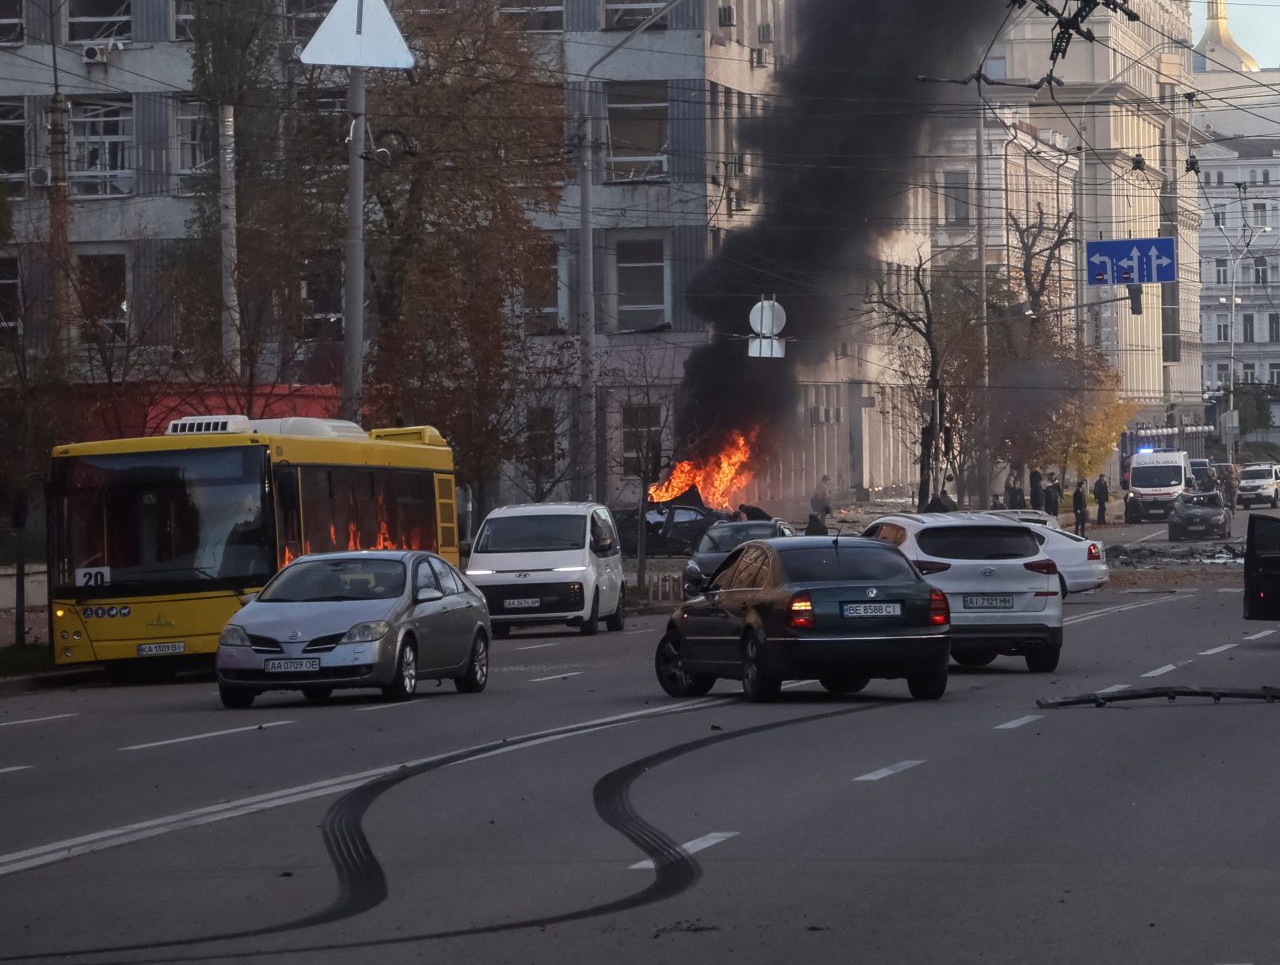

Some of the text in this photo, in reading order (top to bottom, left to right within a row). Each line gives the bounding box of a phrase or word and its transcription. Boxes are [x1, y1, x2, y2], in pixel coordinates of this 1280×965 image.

[83, 571, 104, 587] 20
[848, 605, 861, 615] BE
[863, 605, 883, 614] 8588
[270, 661, 282, 671] AA
[284, 660, 303, 670] 0709
